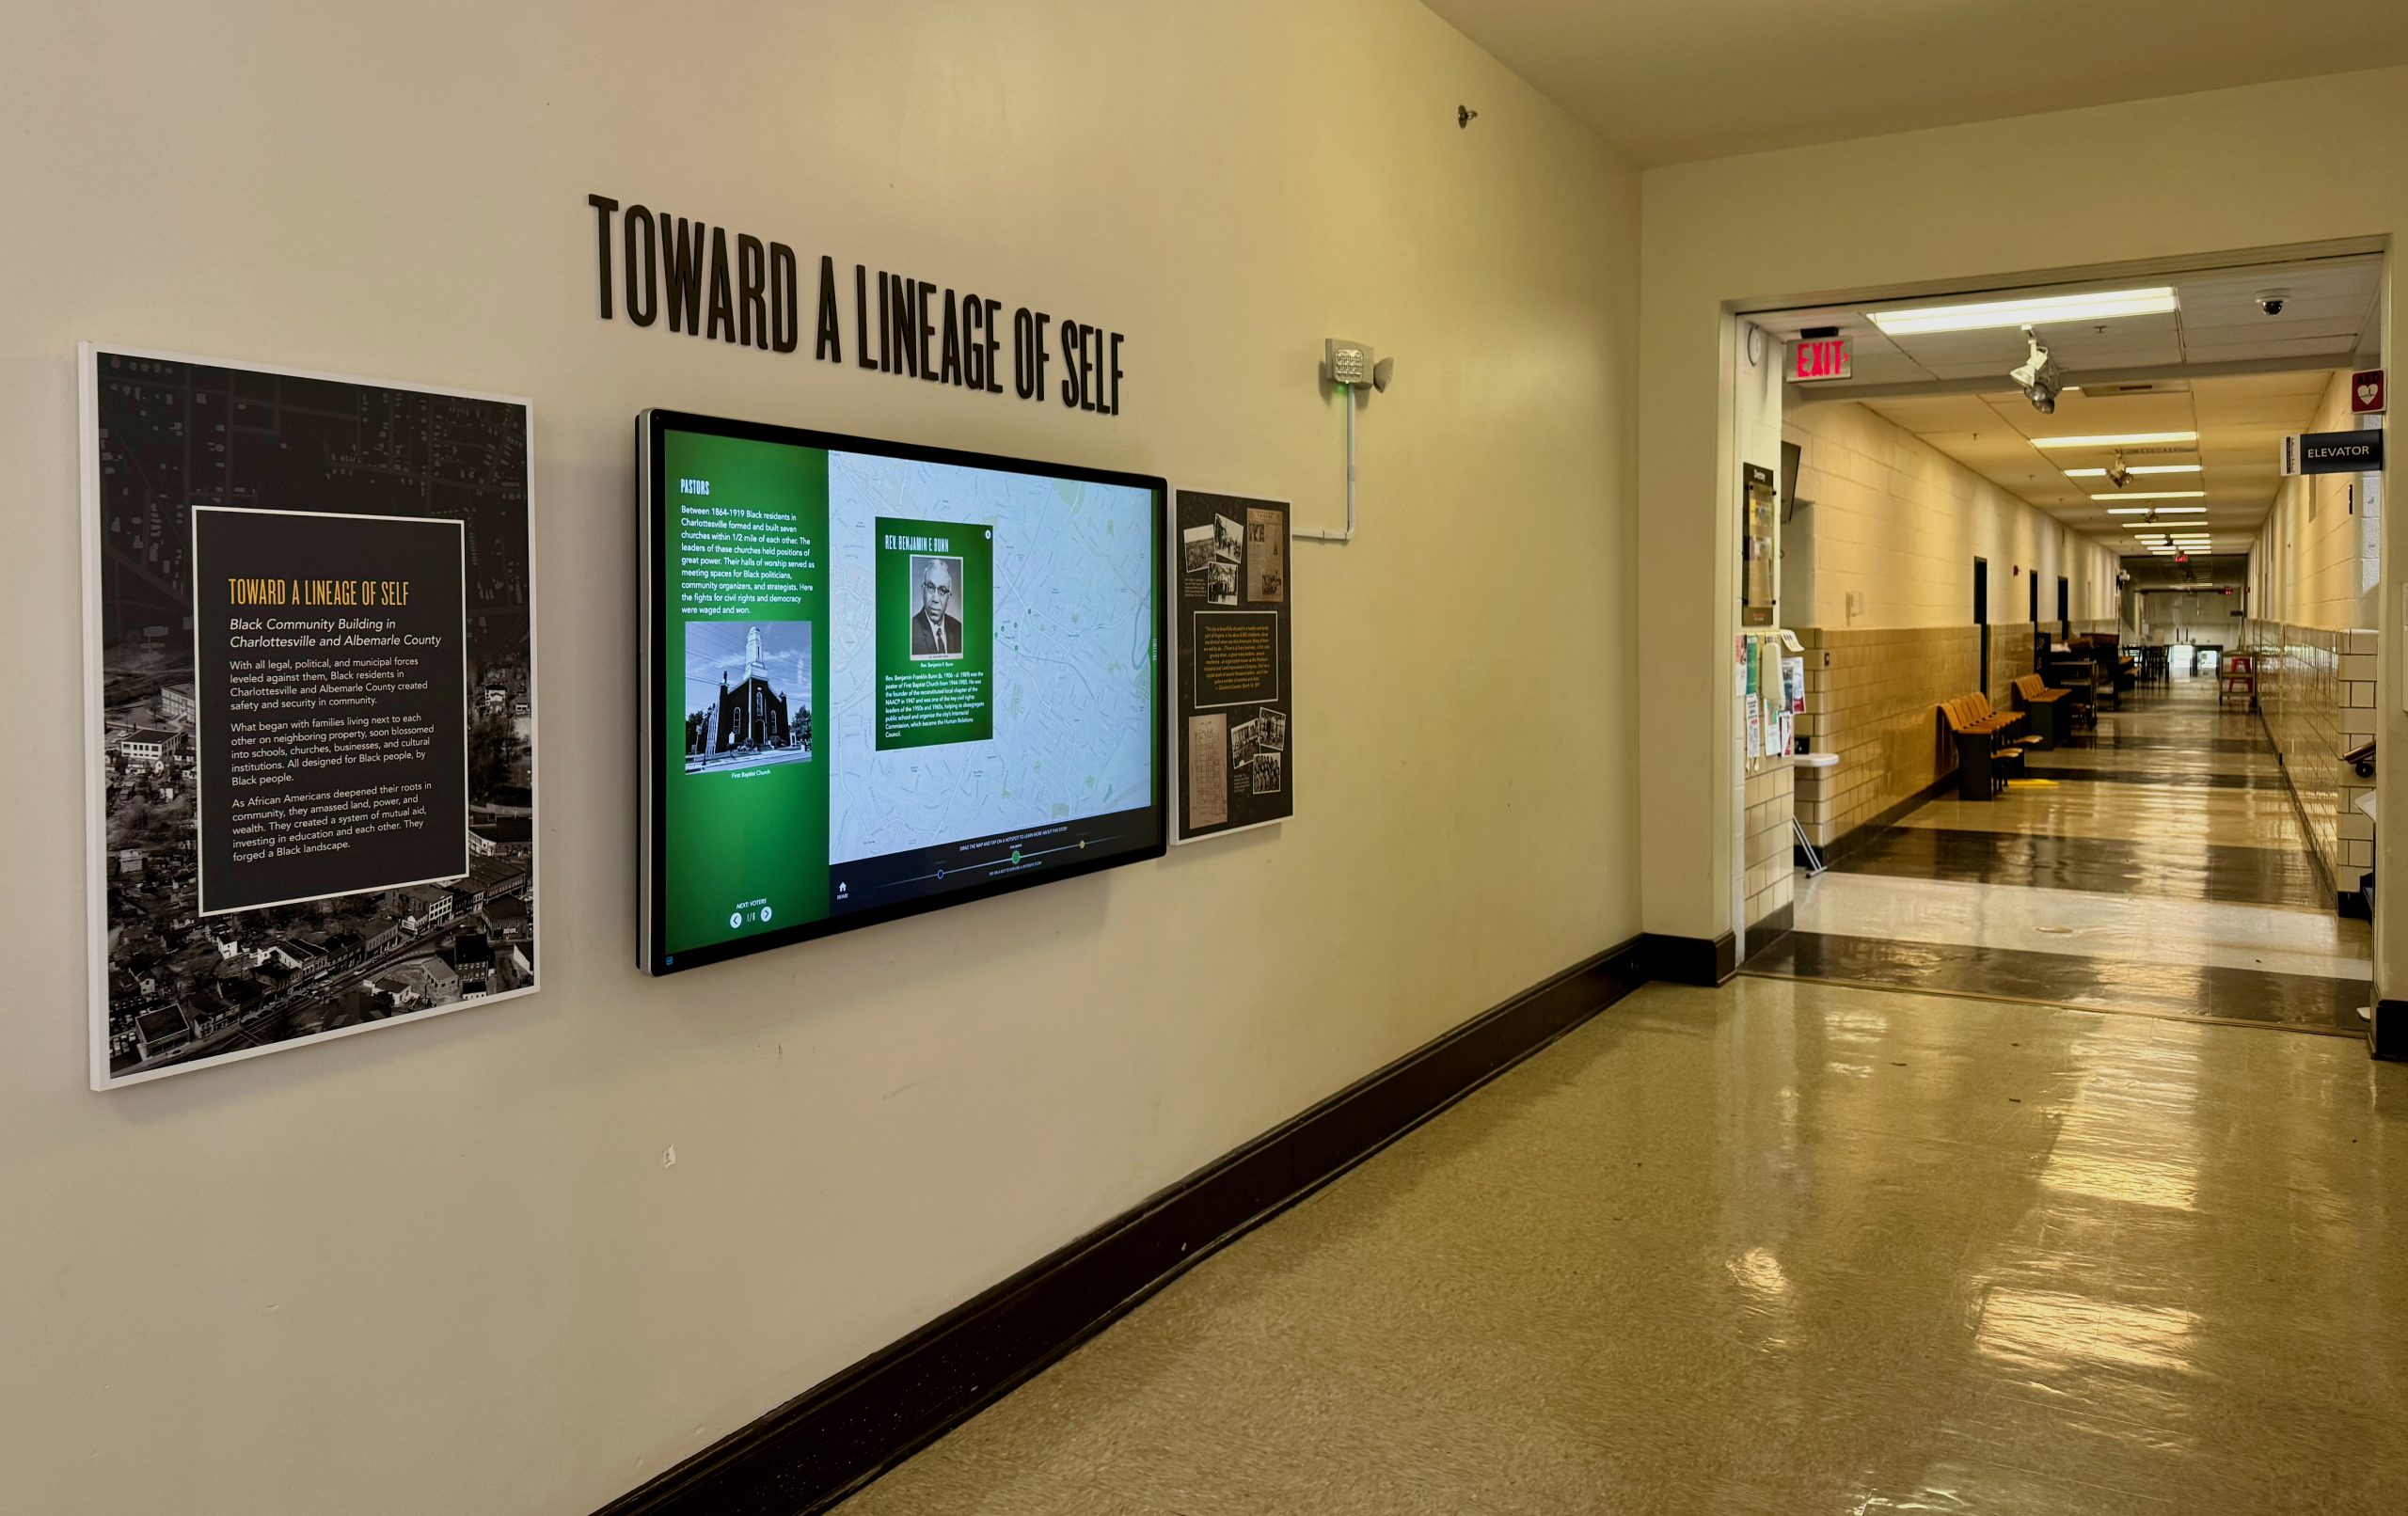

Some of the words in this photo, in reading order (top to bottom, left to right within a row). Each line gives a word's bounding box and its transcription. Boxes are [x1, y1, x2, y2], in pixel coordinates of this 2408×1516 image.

[588, 193, 798, 354] TOWARD
[816, 255, 841, 363] A
[854, 264, 1003, 393] LINEAGE
[1014, 308, 1050, 402] OF
[1062, 319, 1124, 416] SELF
[1798, 341, 1844, 377] EXIT
[2307, 445, 2369, 458] ELEVATOR
[680, 478, 709, 495] PASTORS
[681, 505, 709, 514] Between
[711, 507, 744, 517] 1864-1919
[746, 510, 762, 518] Black
[763, 512, 790, 520] residents
[680, 517, 727, 529] Charlottesville
[728, 520, 751, 529] formed
[765, 523, 779, 531] built
[681, 530, 710, 540] churches
[711, 532, 730, 541] within
[758, 534, 765, 543] of
[800, 536, 810, 545] The
[898, 535, 927, 552] BENJAMIN
[681, 543, 705, 551] leaders
[715, 545, 733, 553] these
[734, 545, 761, 554] churches
[762, 546, 775, 555] held
[776, 548, 802, 557] positions
[681, 557, 699, 565] great
[700, 558, 721, 566] power.
[740, 558, 754, 566] halls
[763, 559, 786, 569] worship
[228, 578, 285, 605] TOWARD
[292, 579, 299, 605] A
[305, 579, 356, 605] LINEAGE
[361, 580, 376, 605] OF
[381, 581, 408, 605] SELF
[230, 618, 262, 630] Black
[266, 618, 335, 632] Community
[338, 617, 383, 632] Building
[386, 618, 395, 628] in
[230, 635, 316, 647] Charlottesville
[319, 634, 341, 646] and
[343, 634, 400, 645] Albemarle
[404, 634, 441, 647] County
[229, 660, 252, 670] With
[255, 659, 265, 669] all
[268, 659, 292, 671] legal,
[294, 657, 331, 670] political,
[334, 657, 350, 667] and
[353, 656, 391, 668] municipal
[394, 656, 418, 665] forces
[230, 672, 263, 683] leveled
[266, 672, 299, 685] against
[302, 671, 327, 681] them,
[330, 670, 354, 680] Black
[356, 670, 394, 679] residents
[230, 685, 297, 697] Charlottesville
[300, 684, 316, 694] and
[319, 683, 363, 693] Albemarle
[365, 682, 395, 692] County
[397, 680, 427, 689] created
[230, 700, 259, 711] safety
[261, 699, 278, 708] and
[281, 698, 316, 709] security
[318, 697, 326, 705] in
[328, 695, 377, 705] community.
[230, 722, 256, 732] What
[259, 721, 288, 732] began
[290, 719, 309, 728] with
[311, 718, 344, 727] families
[347, 717, 369, 727] living
[371, 716, 389, 724] next
[403, 713, 421, 722] each
[230, 735, 256, 746] other
[273, 732, 326, 744] neighboring
[328, 730, 367, 741] property,
[391, 724, 434, 735] blossomed
[231, 750, 249, 759] into
[251, 746, 287, 757] schools,
[290, 744, 331, 754] churches,
[334, 742, 381, 751] businesses,
[383, 738, 399, 748] and
[401, 736, 430, 747] cultural
[231, 761, 284, 772] institutions.
[287, 758, 299, 767] All
[301, 755, 341, 767] designed
[344, 754, 356, 764] for
[358, 752, 381, 763] Black
[383, 750, 413, 763] people,
[416, 750, 425, 760] by
[231, 775, 257, 785] Black
[259, 772, 293, 785] people.
[231, 798, 245, 808] As
[246, 796, 280, 806] African
[283, 792, 330, 803] Americans
[333, 785, 377, 798] deepened
[379, 783, 399, 794] their
[424, 781, 431, 789] in
[232, 808, 285, 821] community,
[288, 806, 308, 816] they
[310, 800, 348, 813] amassed
[350, 798, 371, 809] land,
[373, 797, 400, 809] power,
[403, 794, 418, 803] and
[232, 823, 265, 834] wealth.
[268, 821, 291, 831] They
[293, 815, 327, 828] created
[338, 813, 368, 825] system
[371, 810, 380, 819] of
[382, 807, 409, 818] mutual
[412, 805, 426, 814] aid,
[232, 836, 275, 848] investing
[277, 834, 286, 843] in
[289, 829, 333, 842] education
[336, 826, 353, 836] and
[355, 824, 374, 833] each
[377, 821, 401, 831] other.
[404, 819, 423, 829] They
[232, 848, 265, 862] forged
[277, 845, 301, 856] Black
[303, 842, 350, 852] landscape.
[750, 898, 767, 907] VOTERS
